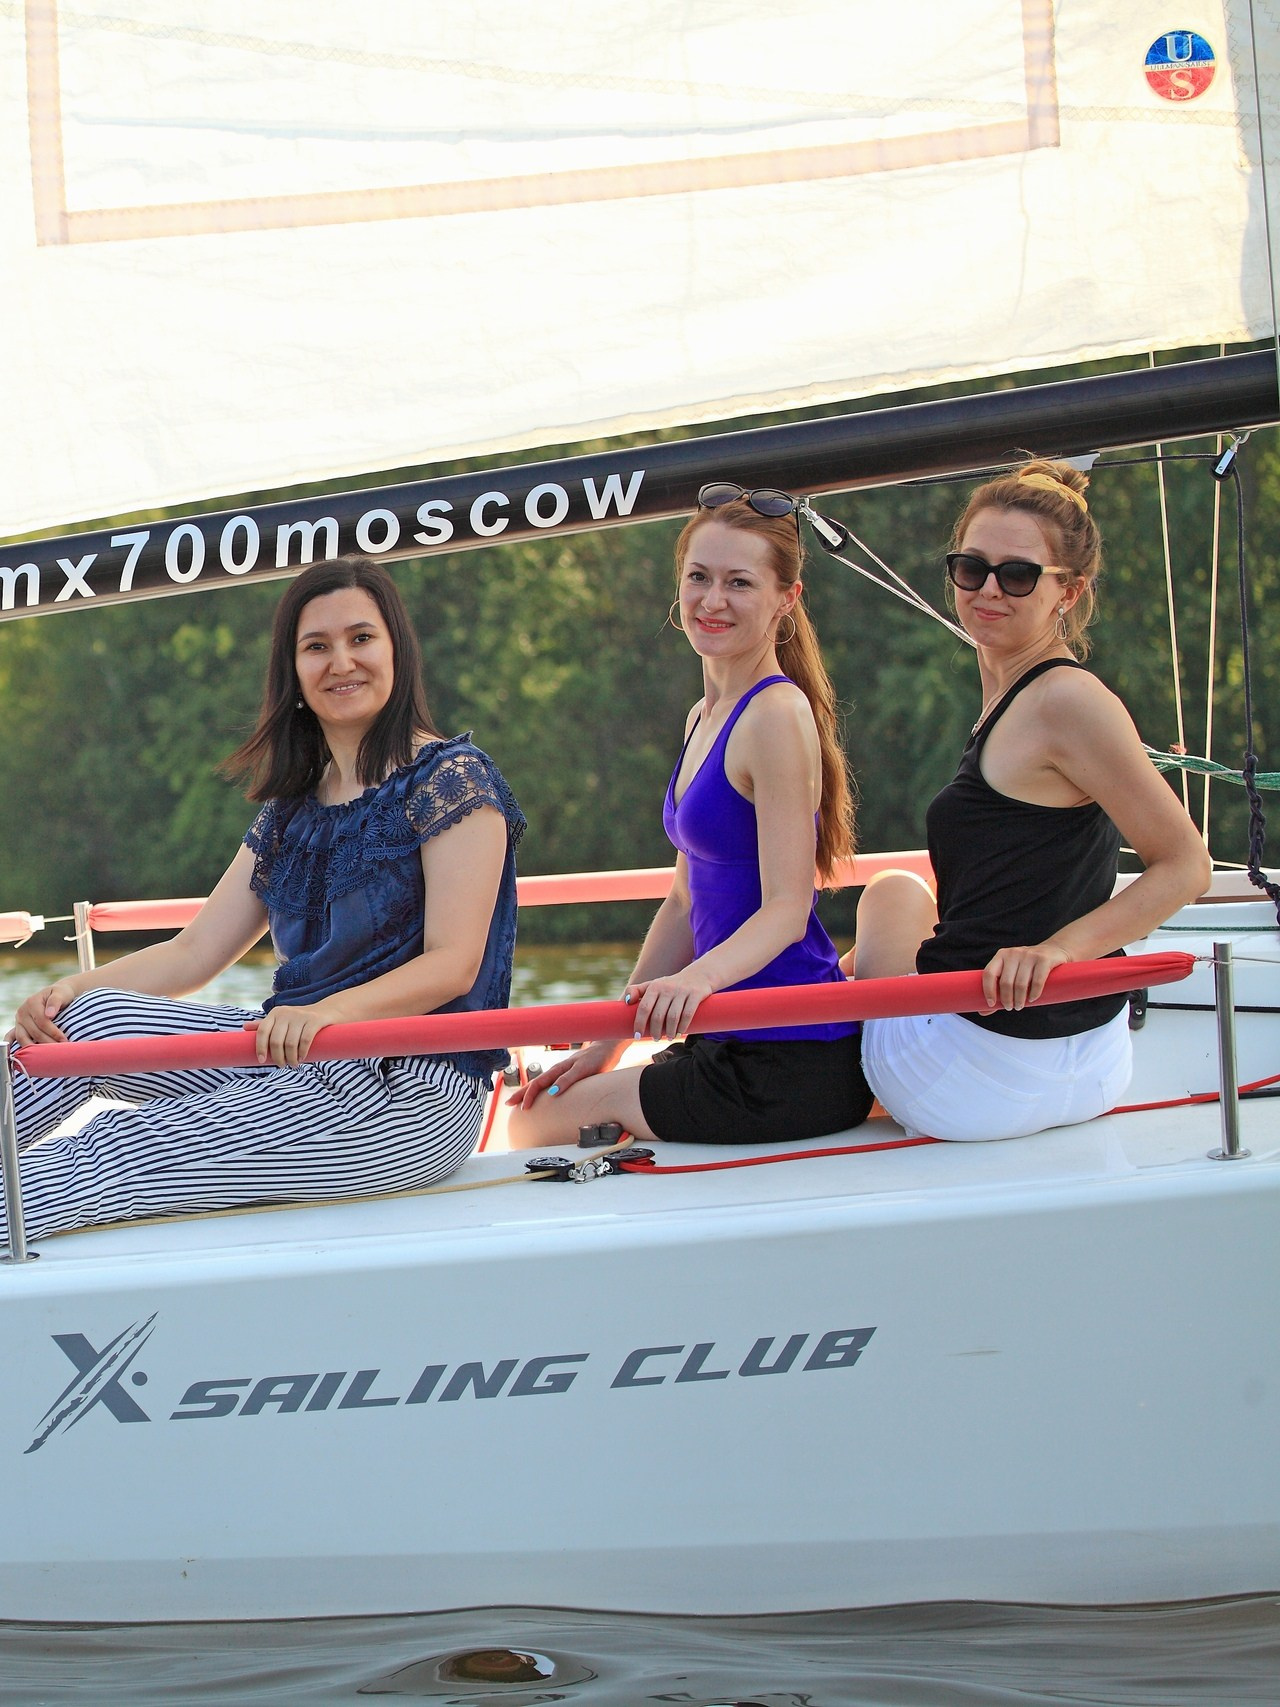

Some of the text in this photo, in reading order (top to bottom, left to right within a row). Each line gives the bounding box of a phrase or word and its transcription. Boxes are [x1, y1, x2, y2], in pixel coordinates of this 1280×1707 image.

[1163, 33, 1194, 62] U
[1169, 69, 1195, 99] S
[169, 1352, 590, 1421] SAILING
[609, 1326, 879, 1390] CLUB
